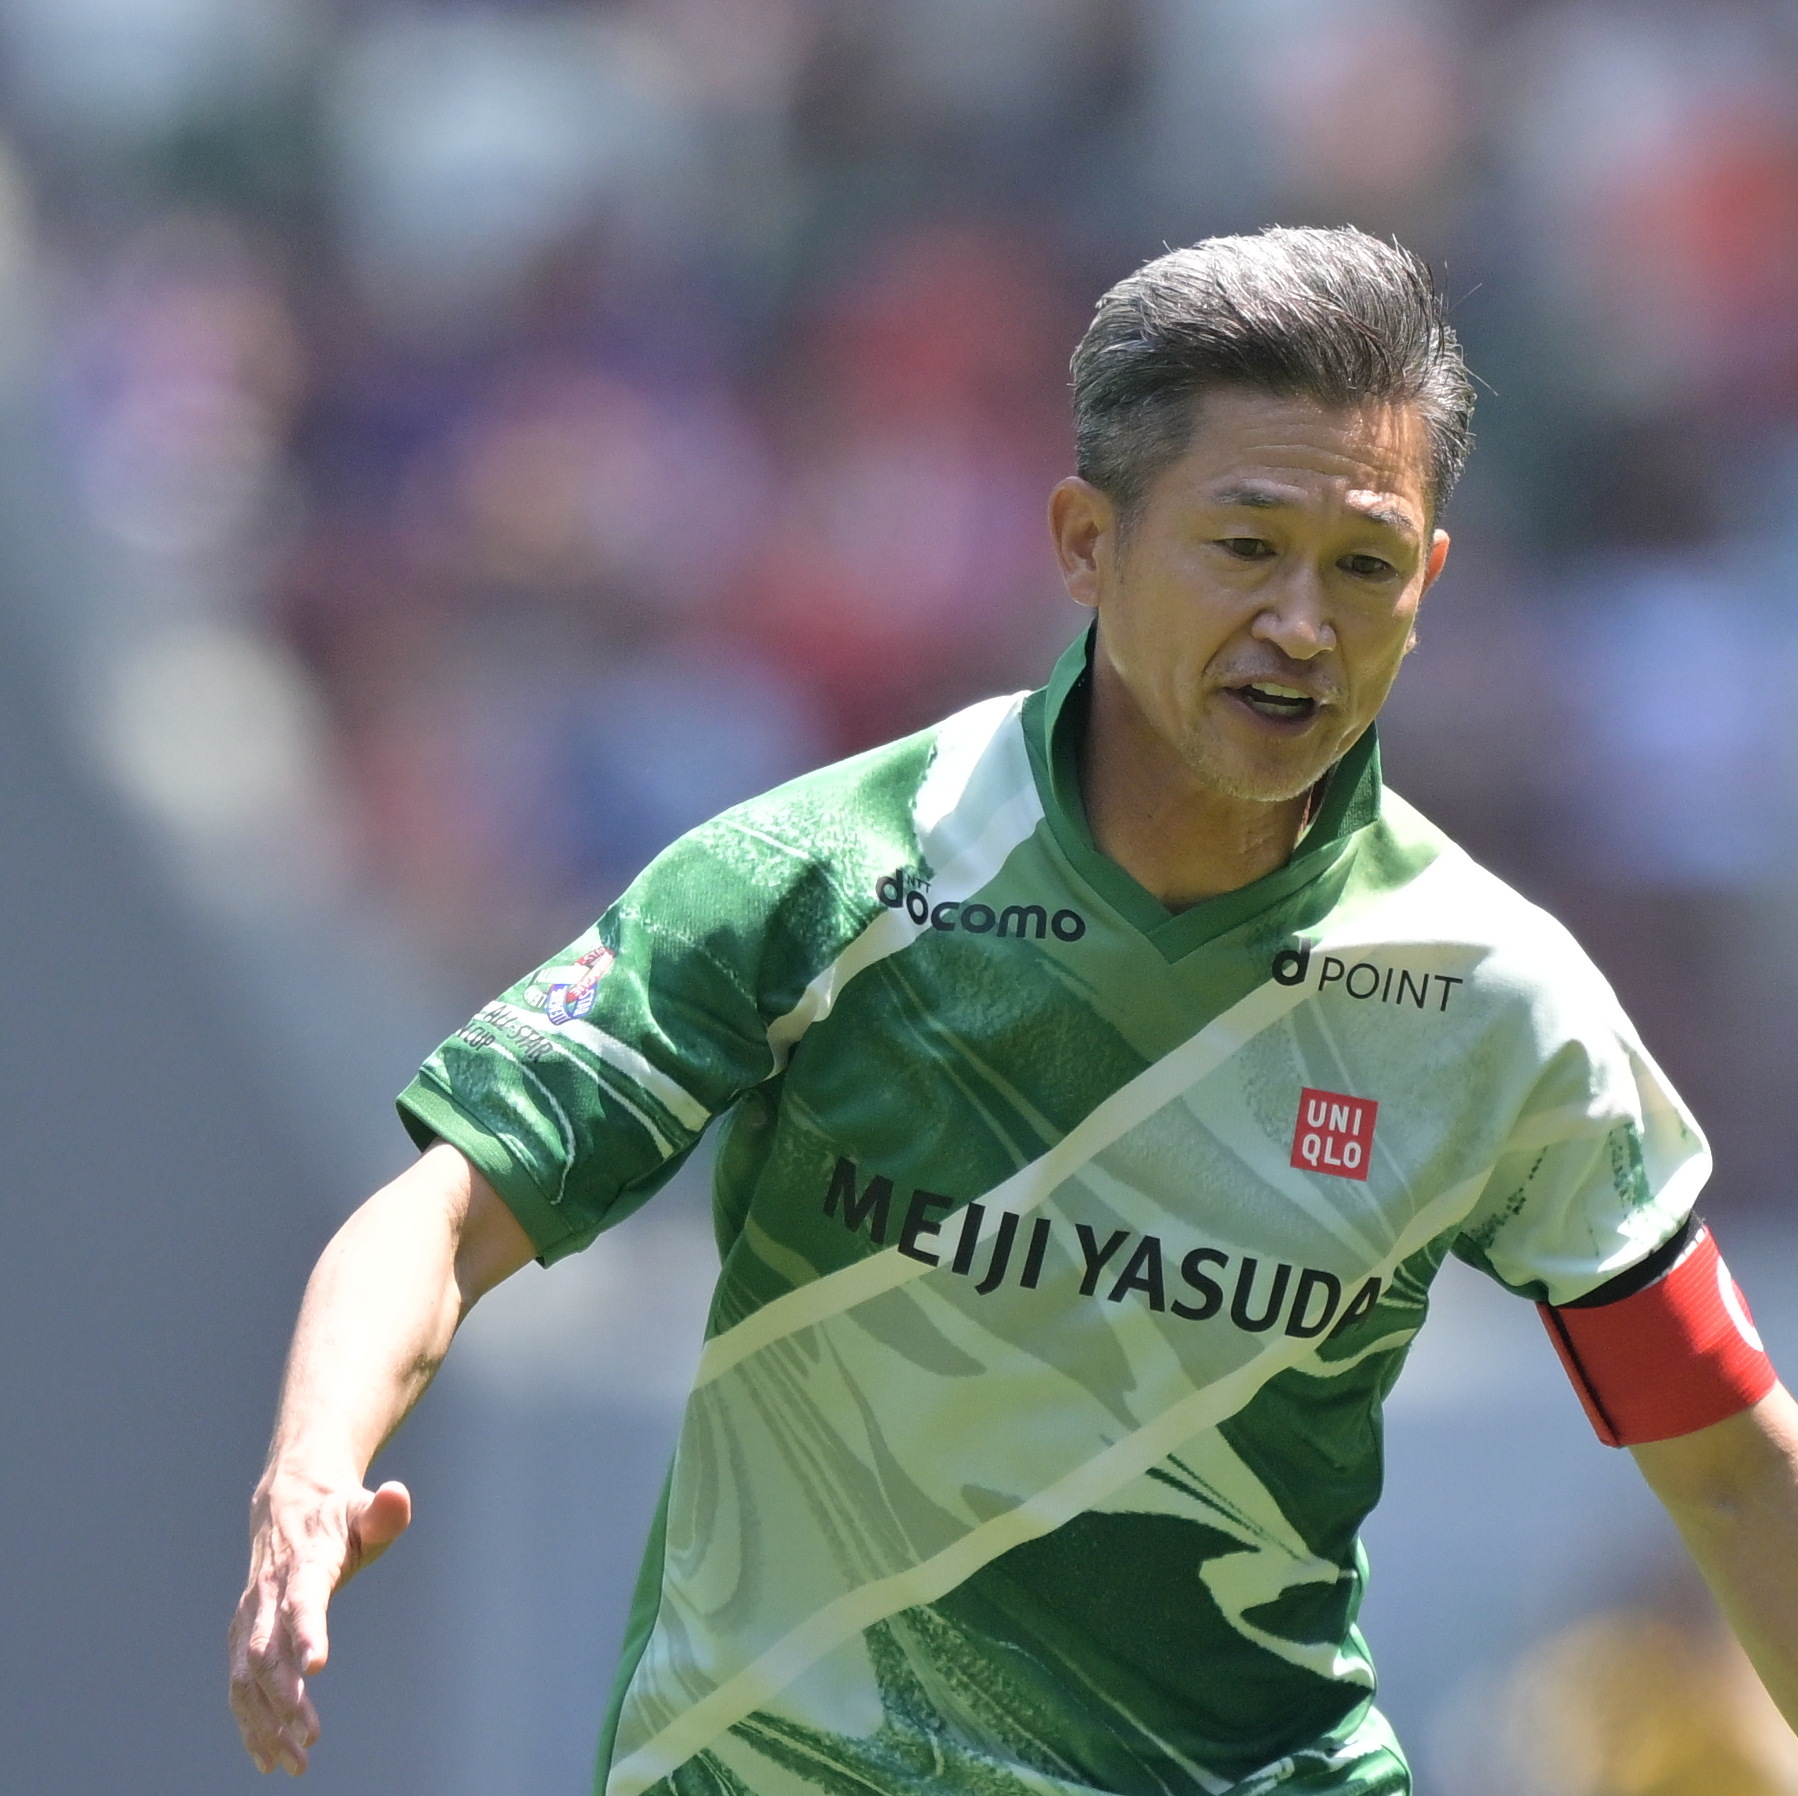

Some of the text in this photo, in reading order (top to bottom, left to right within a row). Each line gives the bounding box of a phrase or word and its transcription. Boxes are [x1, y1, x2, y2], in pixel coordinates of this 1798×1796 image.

[907, 874, 931, 893] NTT
[875, 868, 1086, 942] docomo
[1318, 957, 1464, 1012] POINT
[464, 1026, 496, 1051] CUP
[1307, 1099, 1362, 1136] UNI
[1302, 1133, 1362, 1169] QLO
[822, 1155, 1382, 1339] MEIJI YASUDA
